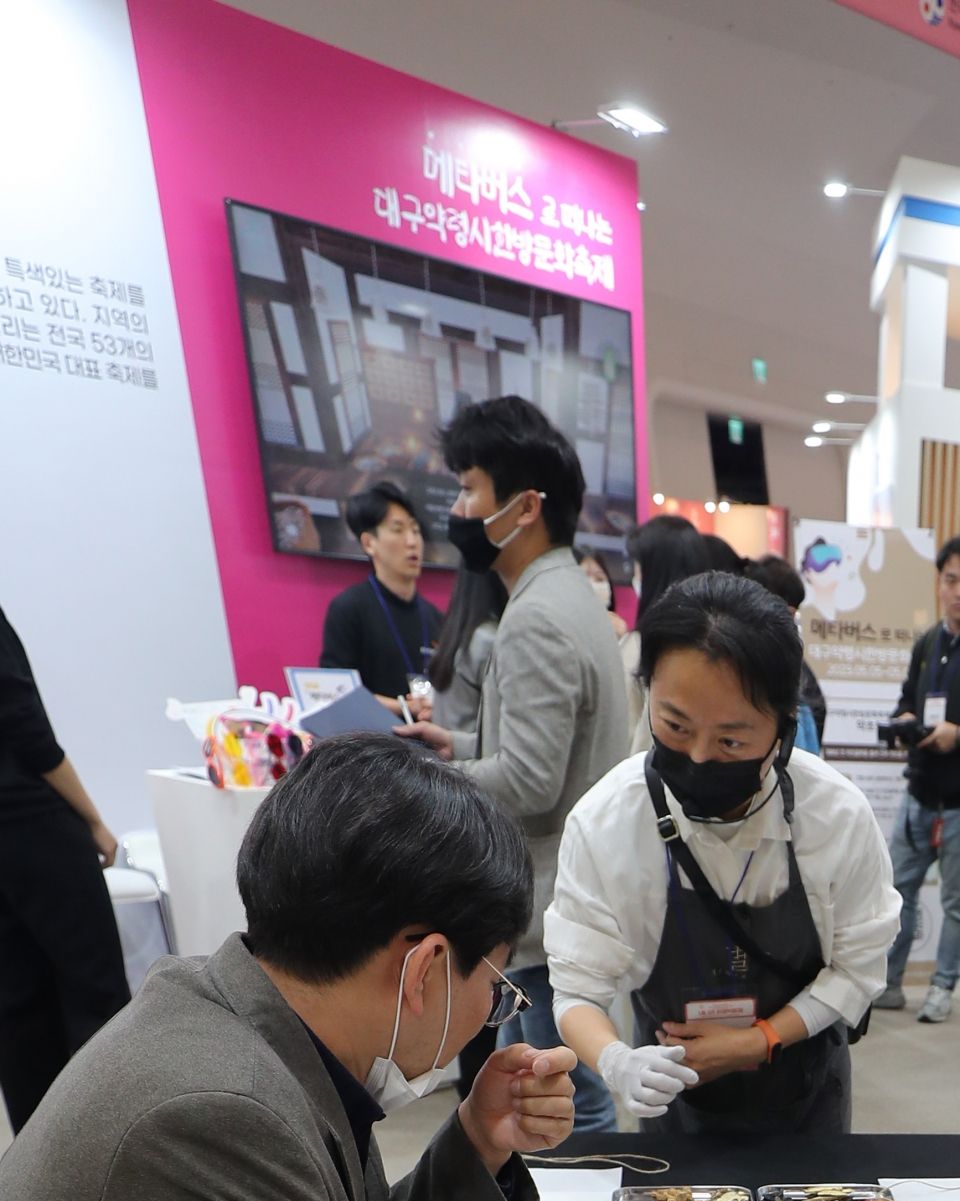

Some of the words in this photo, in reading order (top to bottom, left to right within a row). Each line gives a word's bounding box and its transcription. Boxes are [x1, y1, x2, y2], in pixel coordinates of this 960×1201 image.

[5, 257, 83, 294] 특색있는
[90, 276, 146, 307] 축제를
[40, 294, 87, 322] 있다.
[92, 304, 149, 335] 지역의
[47, 323, 86, 349] 전국
[91, 331, 154, 362] 53개의
[0, 343, 61, 374] 한민국
[64, 353, 103, 380] 대표
[106, 361, 159, 390] 축제를
